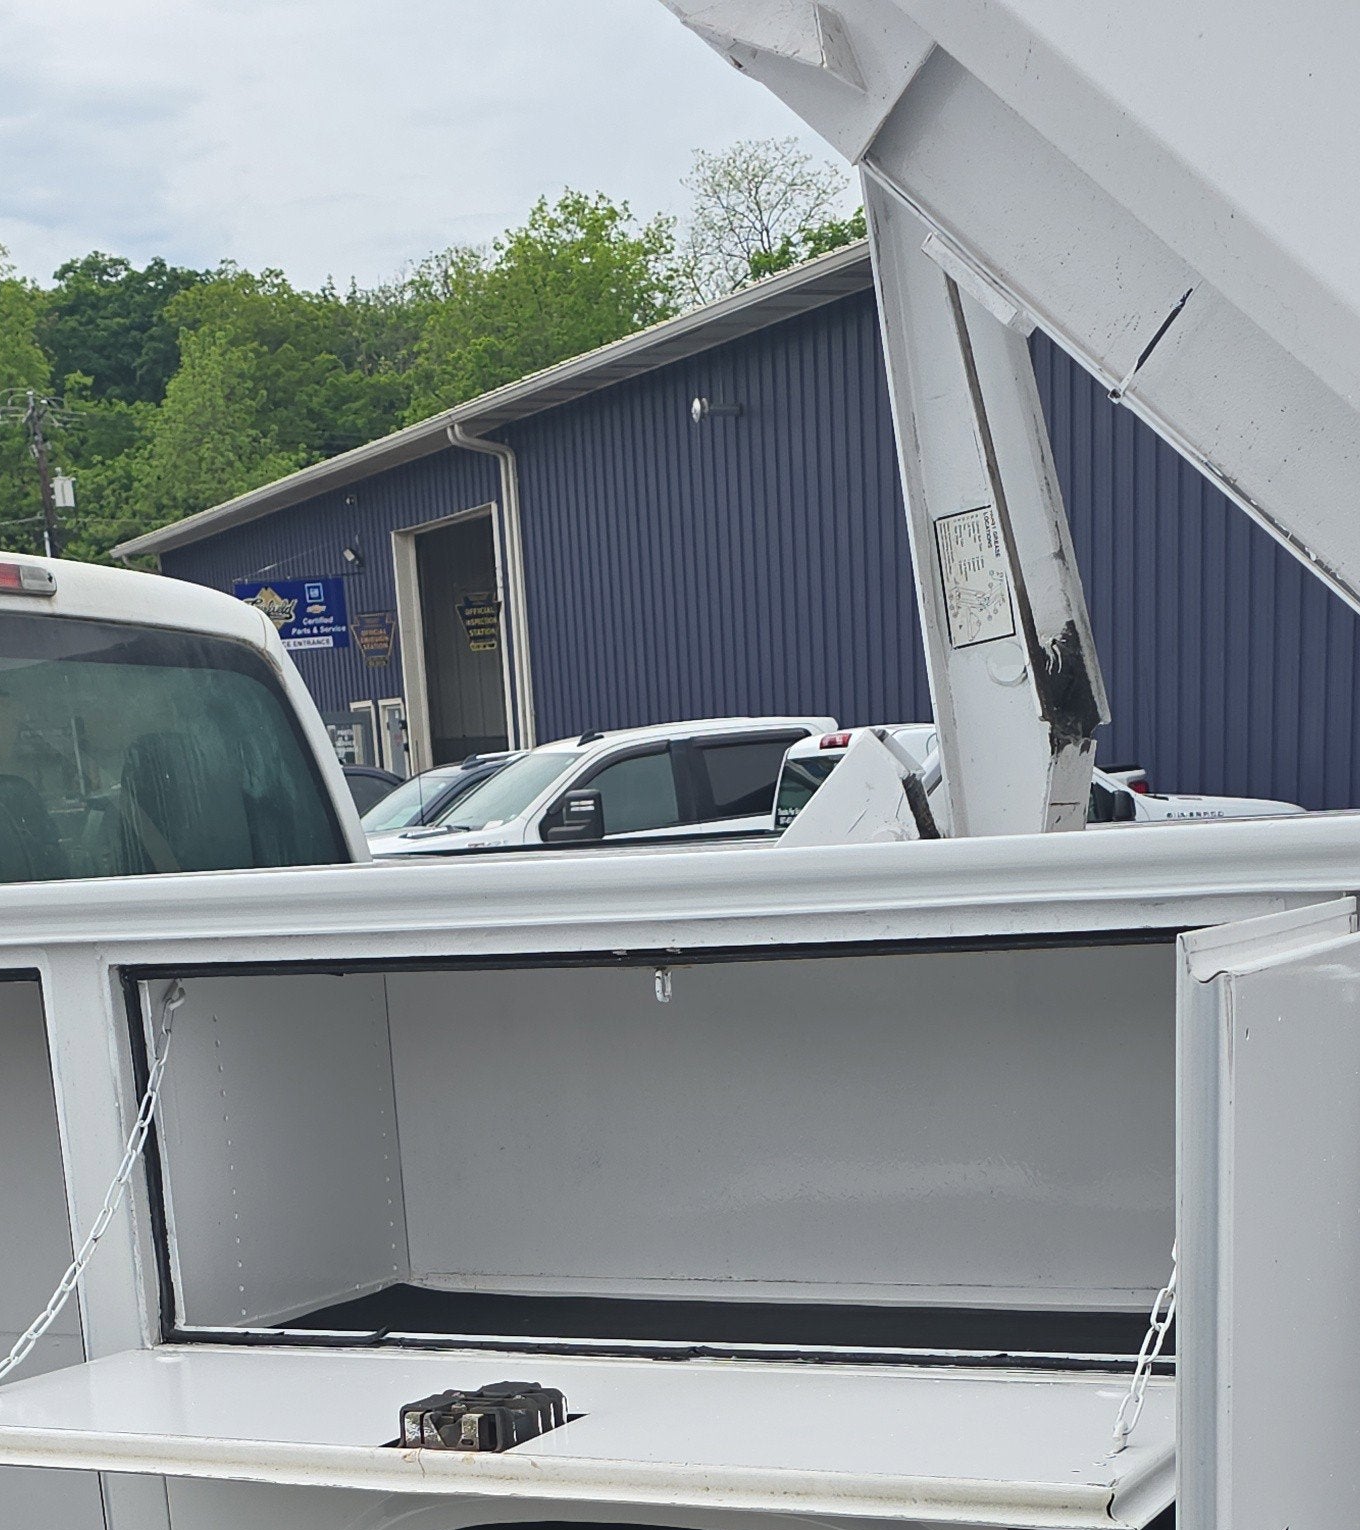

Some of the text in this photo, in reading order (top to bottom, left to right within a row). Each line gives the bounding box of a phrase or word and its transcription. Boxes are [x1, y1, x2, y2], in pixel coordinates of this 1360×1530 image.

[464, 606, 495, 615] OFFICIAL
[302, 616, 334, 625] Certified
[291, 627, 311, 635] Parts
[320, 625, 346, 634] Service
[469, 628, 496, 637] STATION
[293, 639, 330, 648] ENTRANCE
